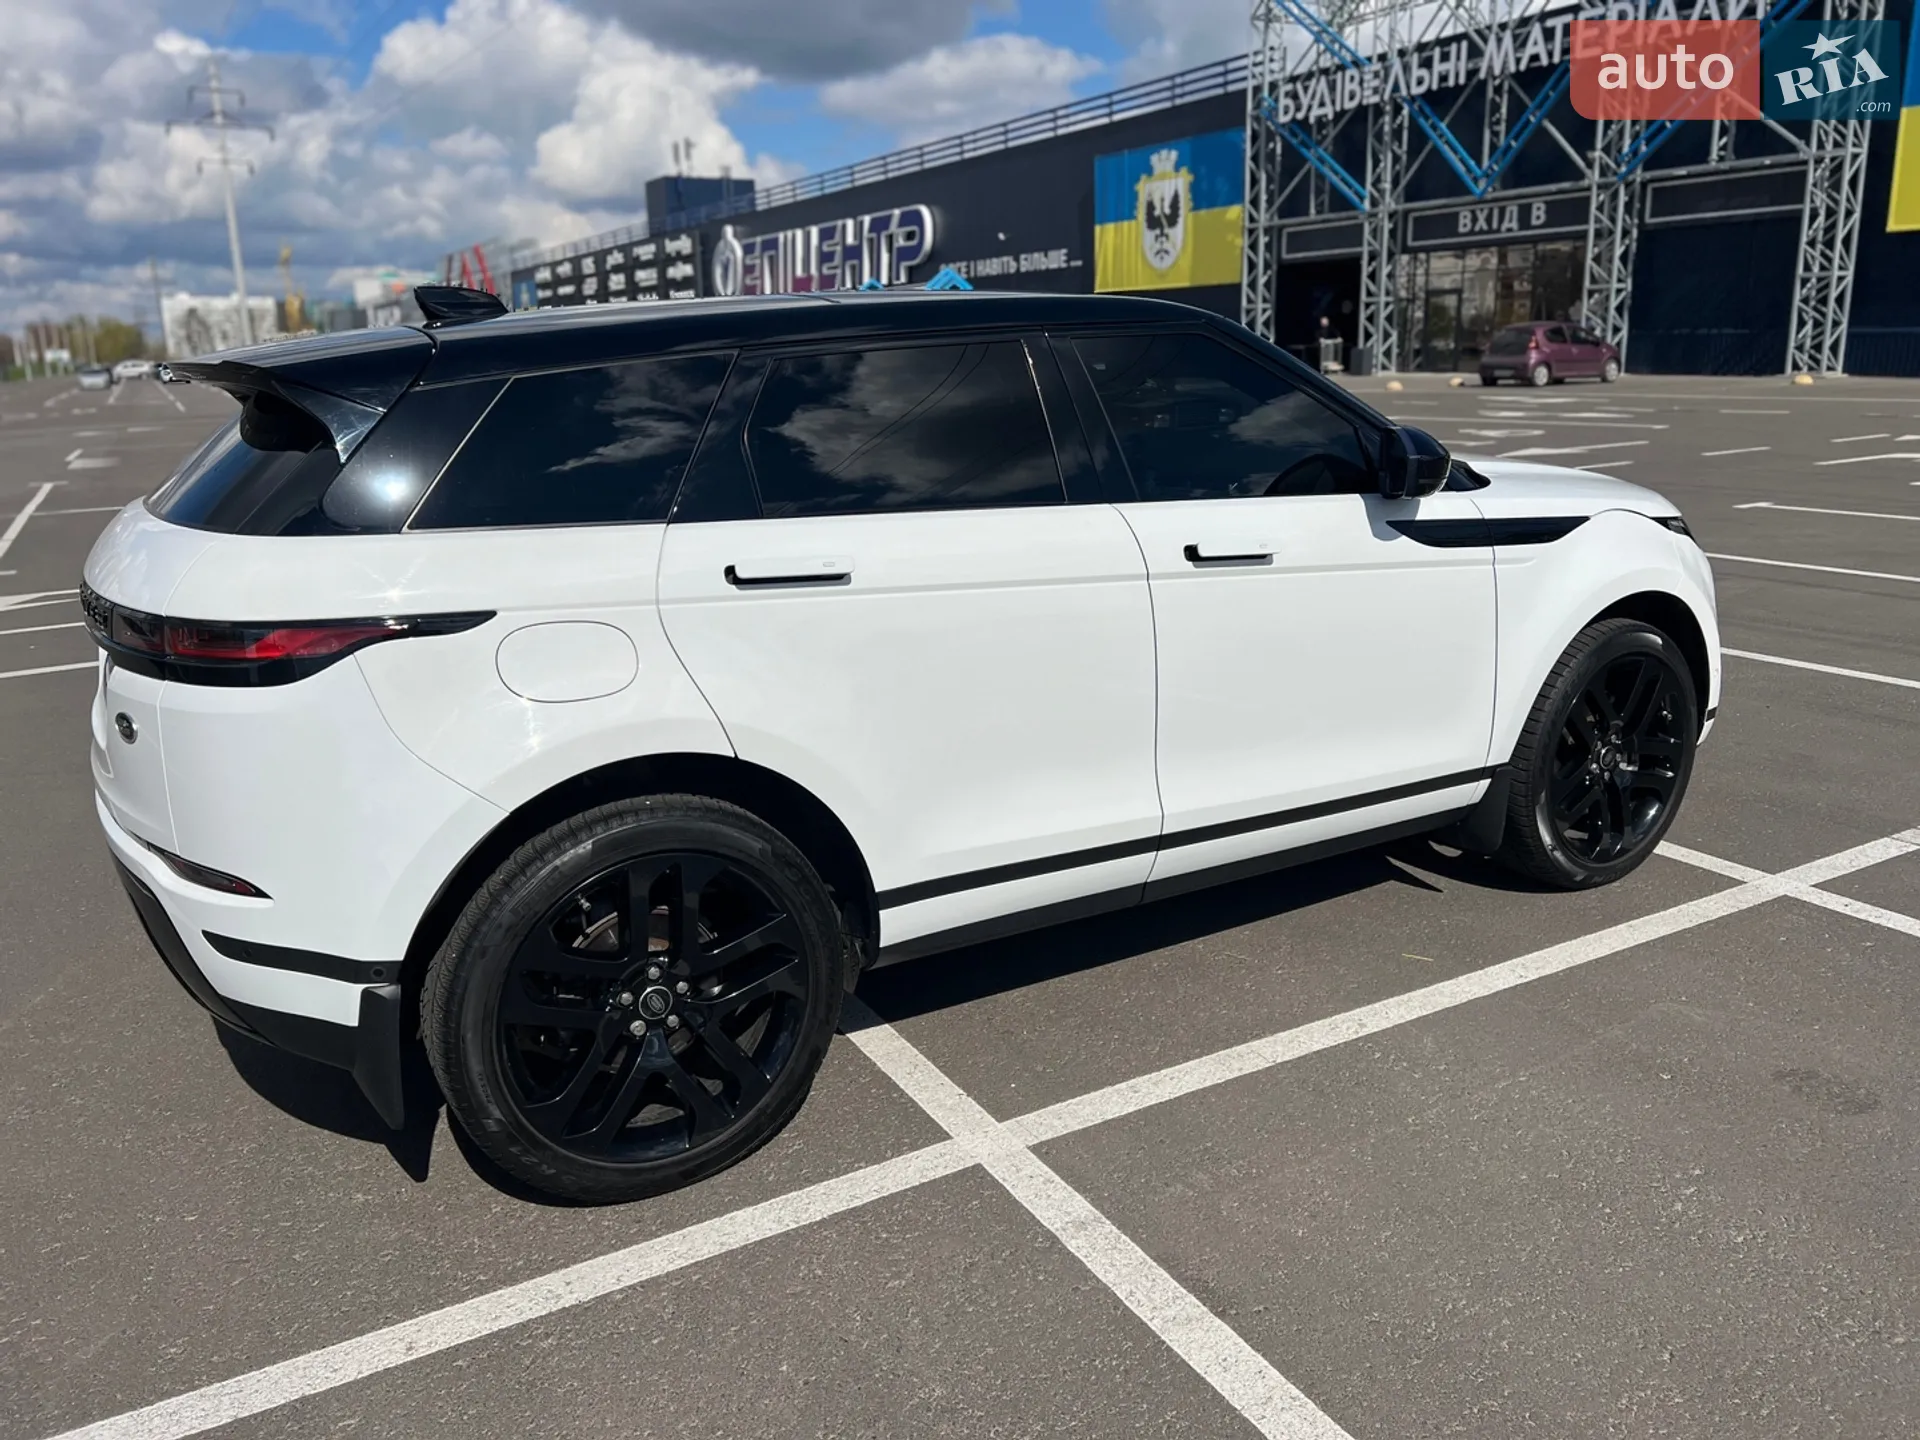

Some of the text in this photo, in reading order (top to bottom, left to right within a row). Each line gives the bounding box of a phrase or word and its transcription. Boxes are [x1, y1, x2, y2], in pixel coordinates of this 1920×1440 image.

[1278, 40, 1468, 124] БУДІВЕЛЬНІ
[742, 204, 934, 295] ЕПІЦЕНТР
[1457, 201, 1547, 234] ВХІД В
